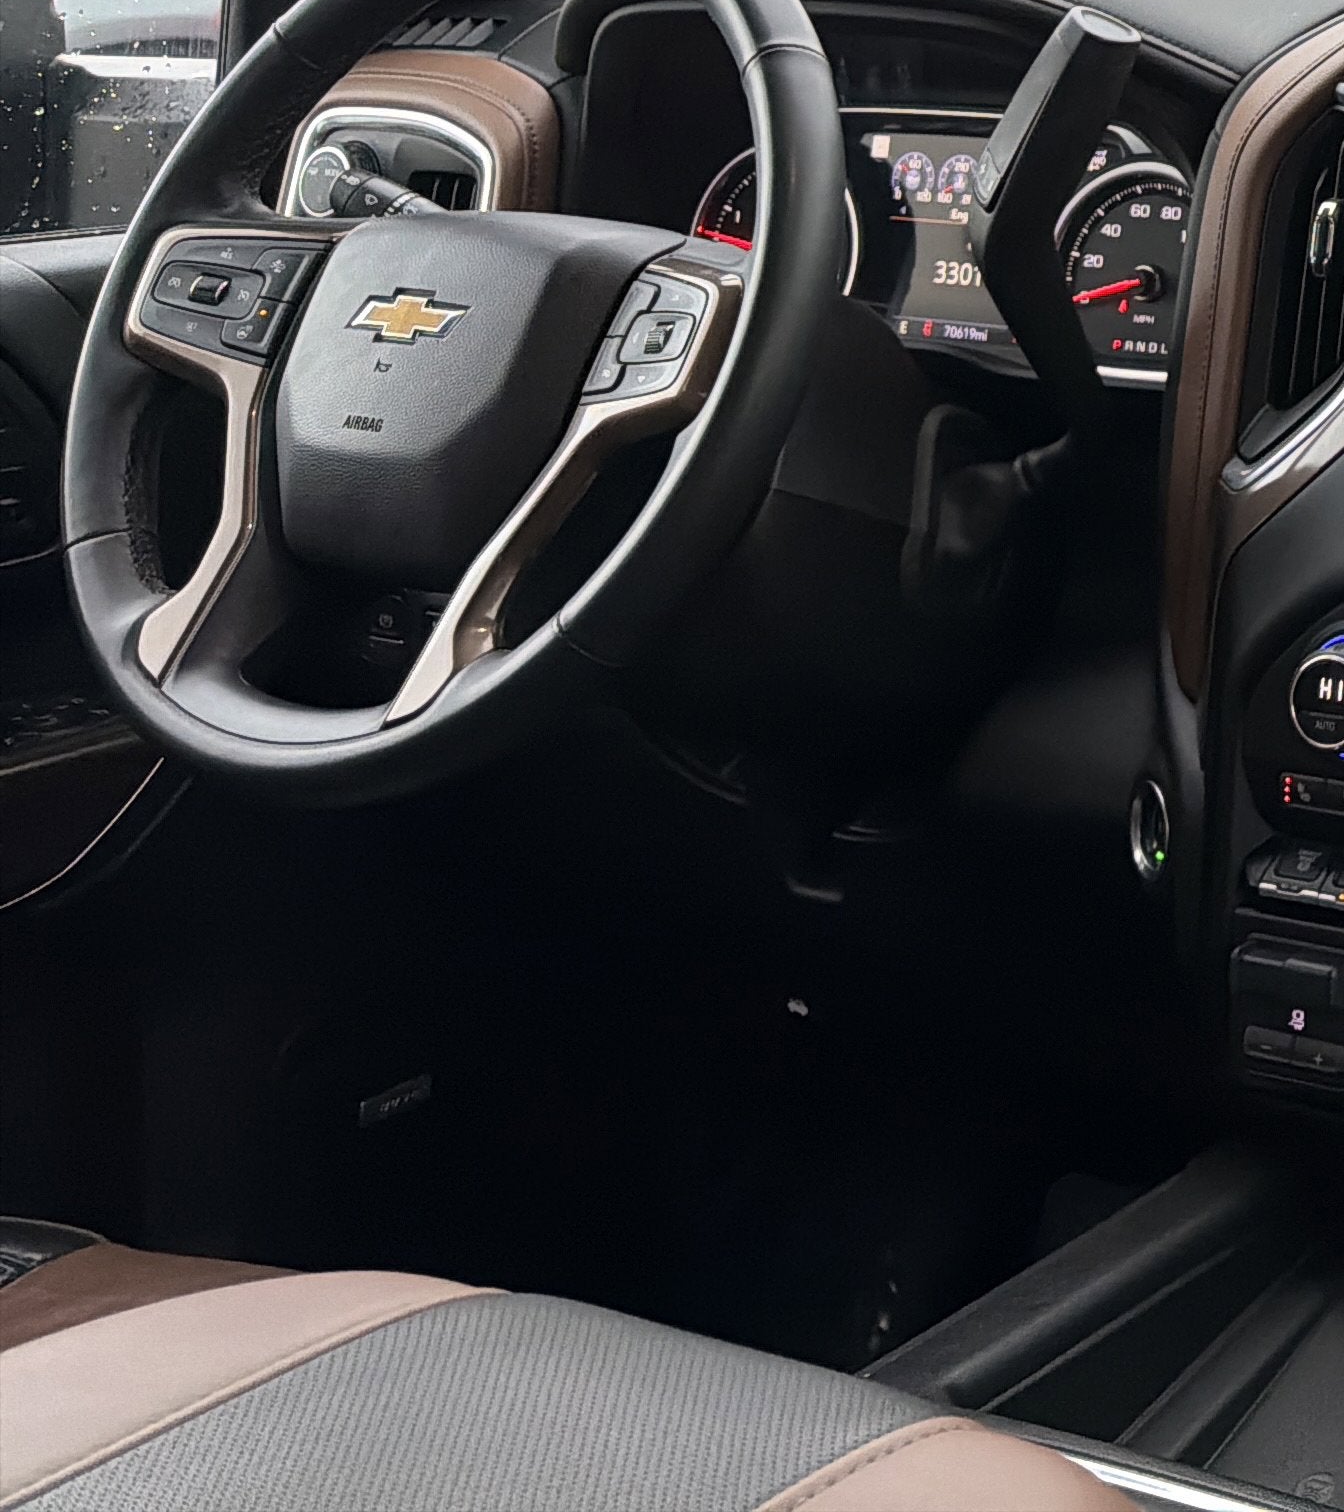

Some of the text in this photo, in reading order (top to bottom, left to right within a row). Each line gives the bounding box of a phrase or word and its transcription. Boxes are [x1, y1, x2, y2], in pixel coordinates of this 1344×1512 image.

[1129, 203, 1150, 219] 60
[1160, 206, 1182, 221] 80
[1101, 223, 1122, 238] 40
[1082, 254, 1104, 269] 20
[1133, 313, 1155, 326] MPH
[342, 414, 385, 433] AIRBAG
[1318, 676, 1344, 704] HI
[1313, 719, 1337, 733] AUTO
